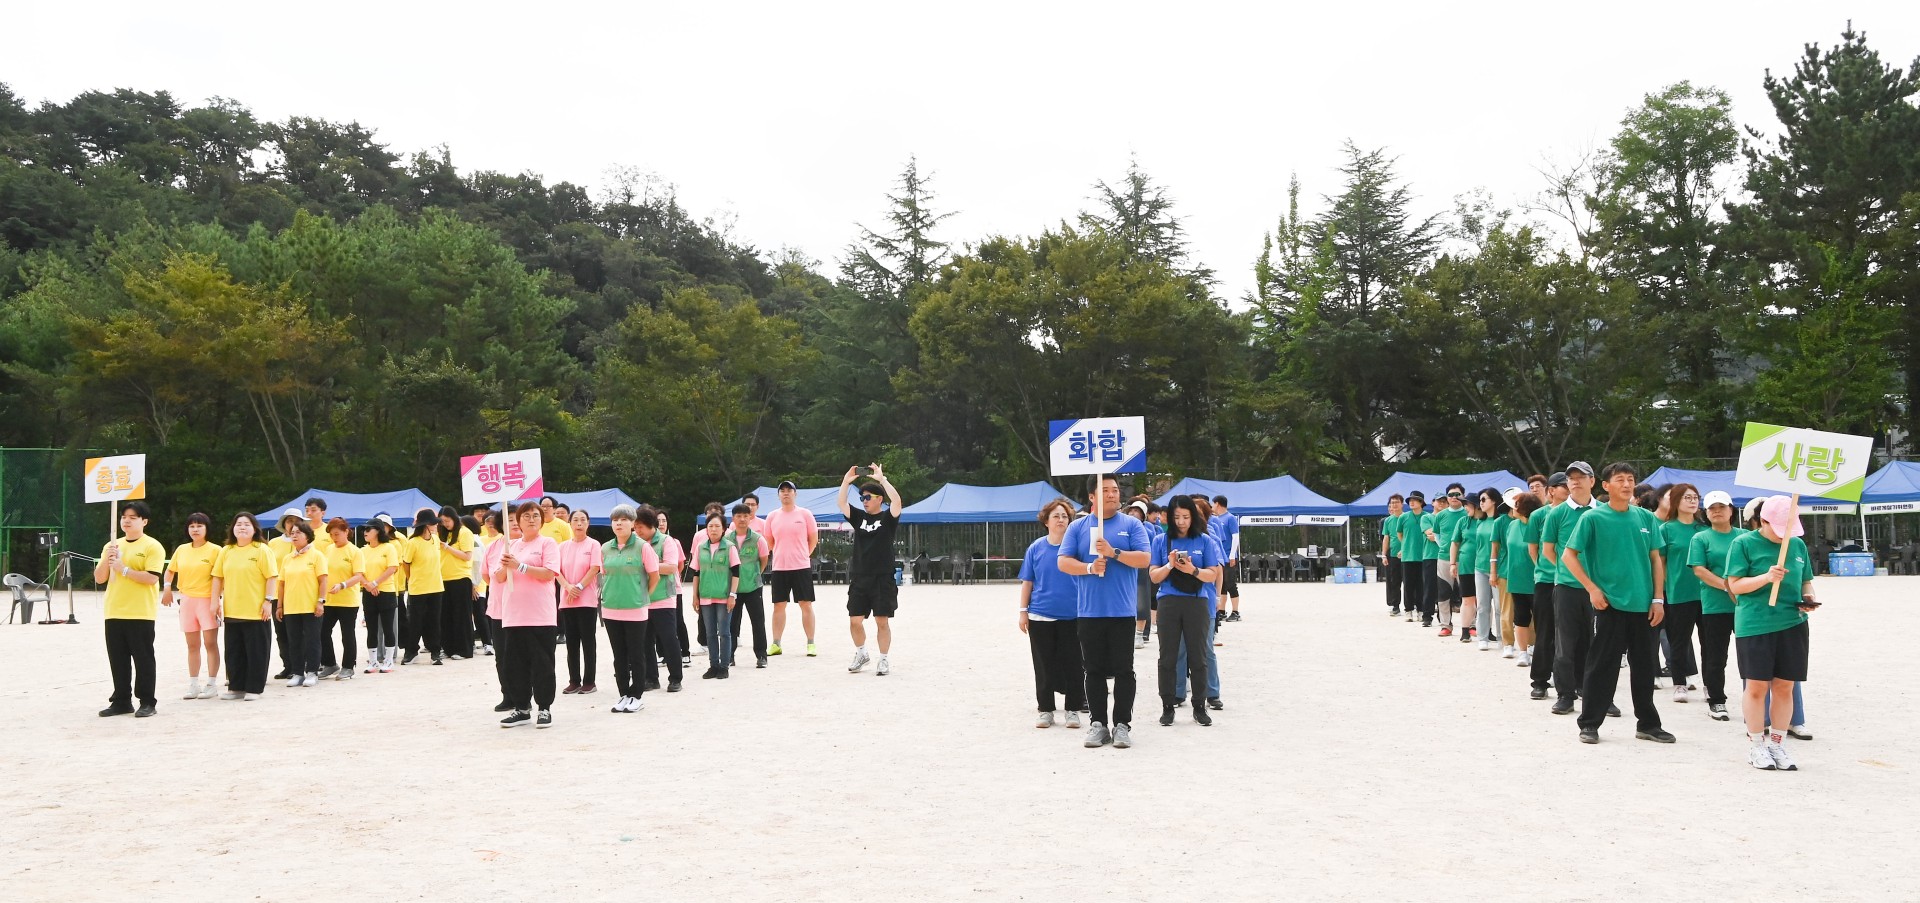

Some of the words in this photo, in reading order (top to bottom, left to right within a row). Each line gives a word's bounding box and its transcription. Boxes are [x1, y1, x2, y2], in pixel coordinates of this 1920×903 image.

[1068, 429, 1126, 463] 화합
[96, 465, 133, 494] 충효
[477, 461, 527, 493] 행복
[1764, 442, 1845, 485] 사랑
